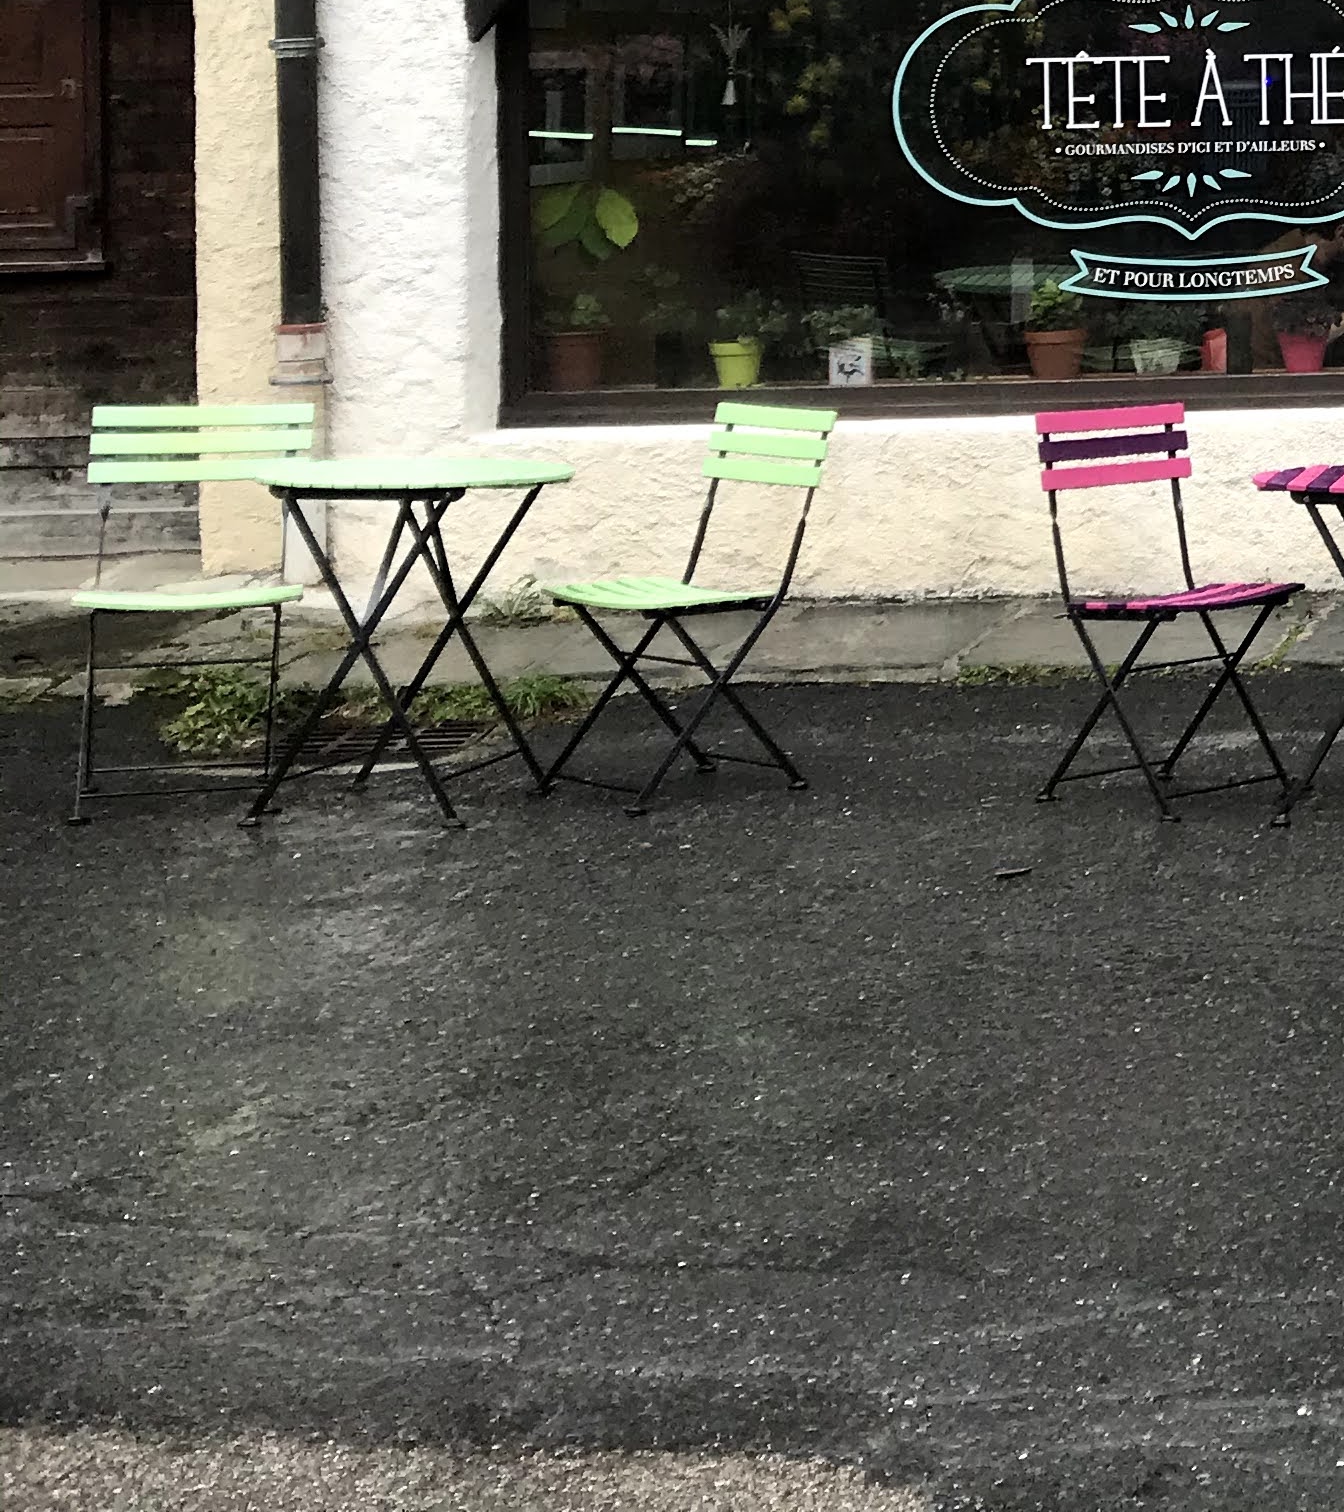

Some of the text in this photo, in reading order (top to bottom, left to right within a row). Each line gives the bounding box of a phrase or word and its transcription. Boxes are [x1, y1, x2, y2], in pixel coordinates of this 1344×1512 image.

[1025, 50, 1171, 131] TÊTE
[1190, 47, 1233, 128] À
[1065, 140, 1316, 156] GOURMANDISES D'ICI ET D'AILLEURS
[1093, 263, 1295, 289] ET POUR LONGTEMPS
